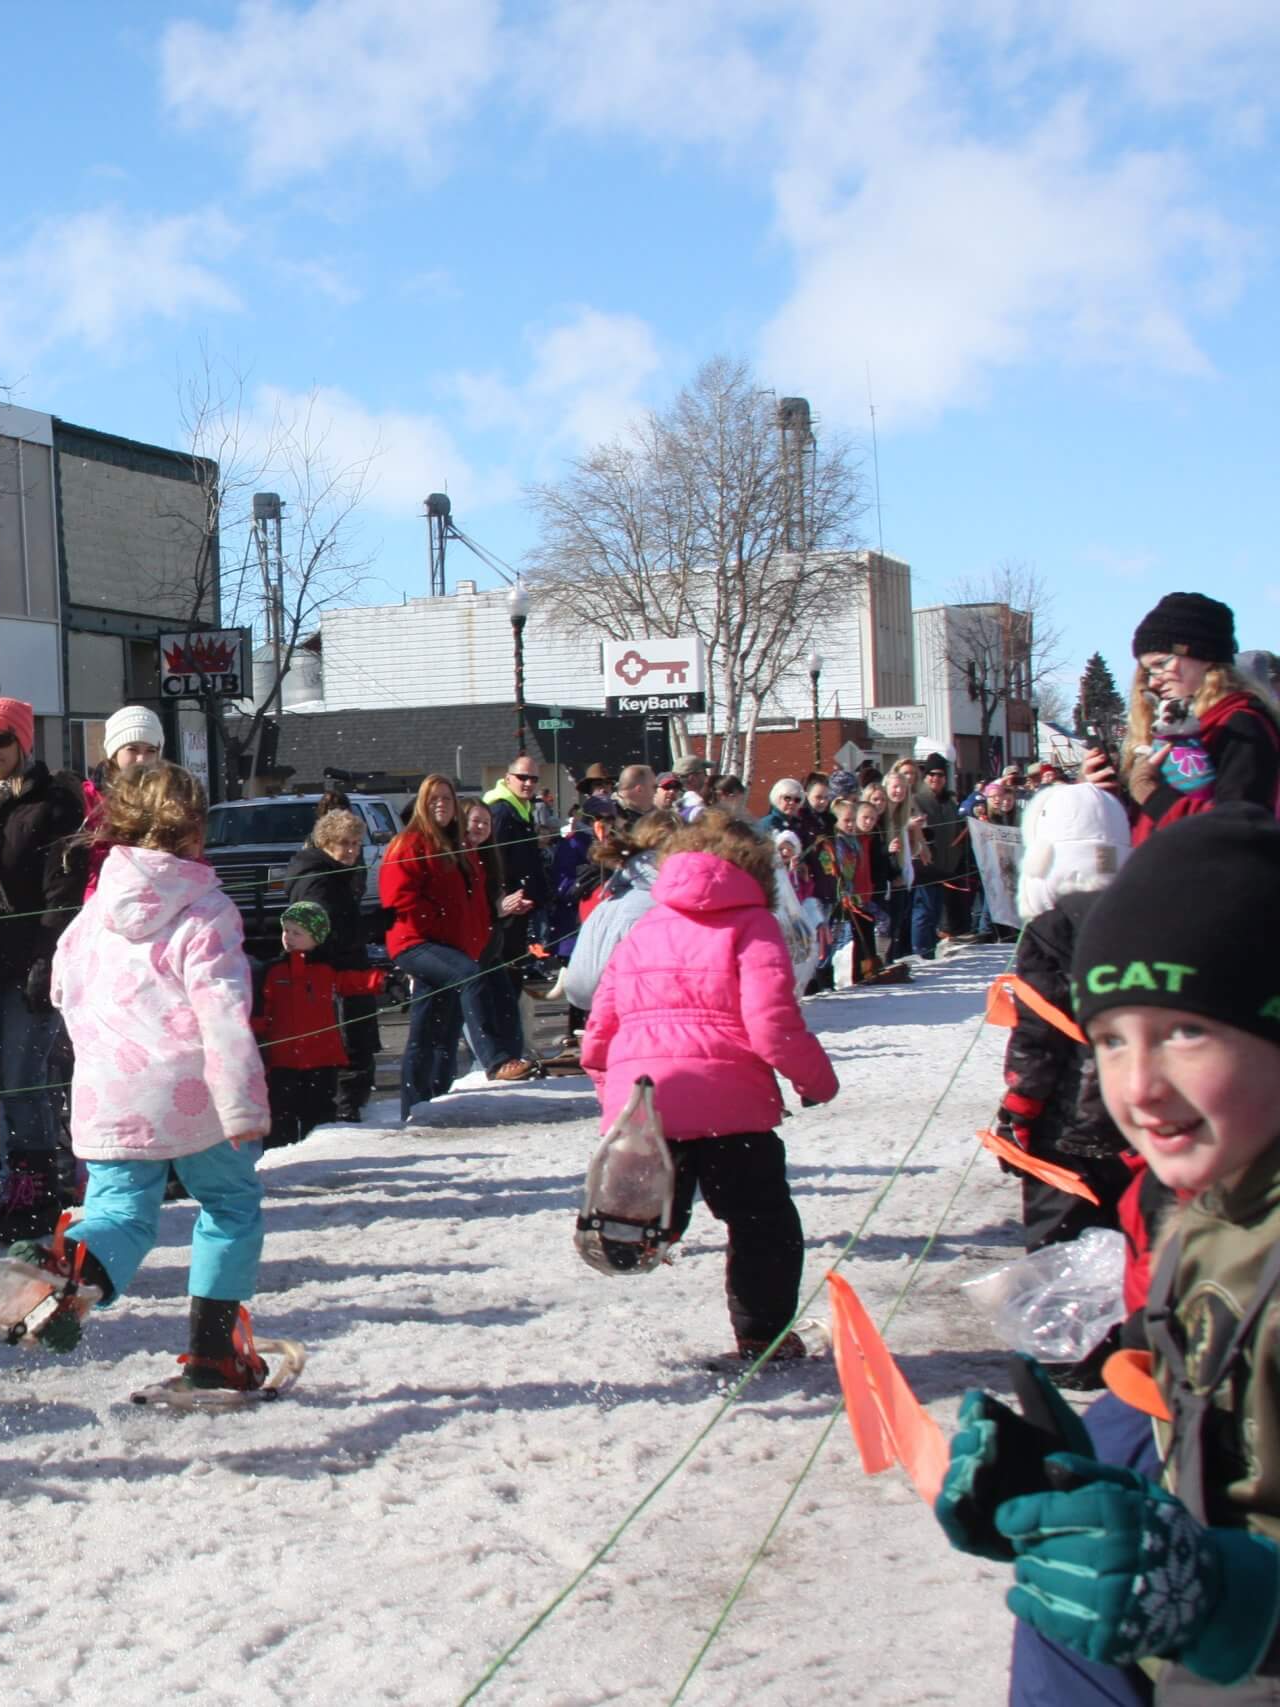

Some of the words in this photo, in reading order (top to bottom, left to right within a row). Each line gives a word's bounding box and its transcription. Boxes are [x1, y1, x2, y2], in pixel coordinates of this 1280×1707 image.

[163, 673, 240, 696] CLUB
[619, 695, 689, 713] KeyBank
[1086, 960, 1198, 994] CAT
